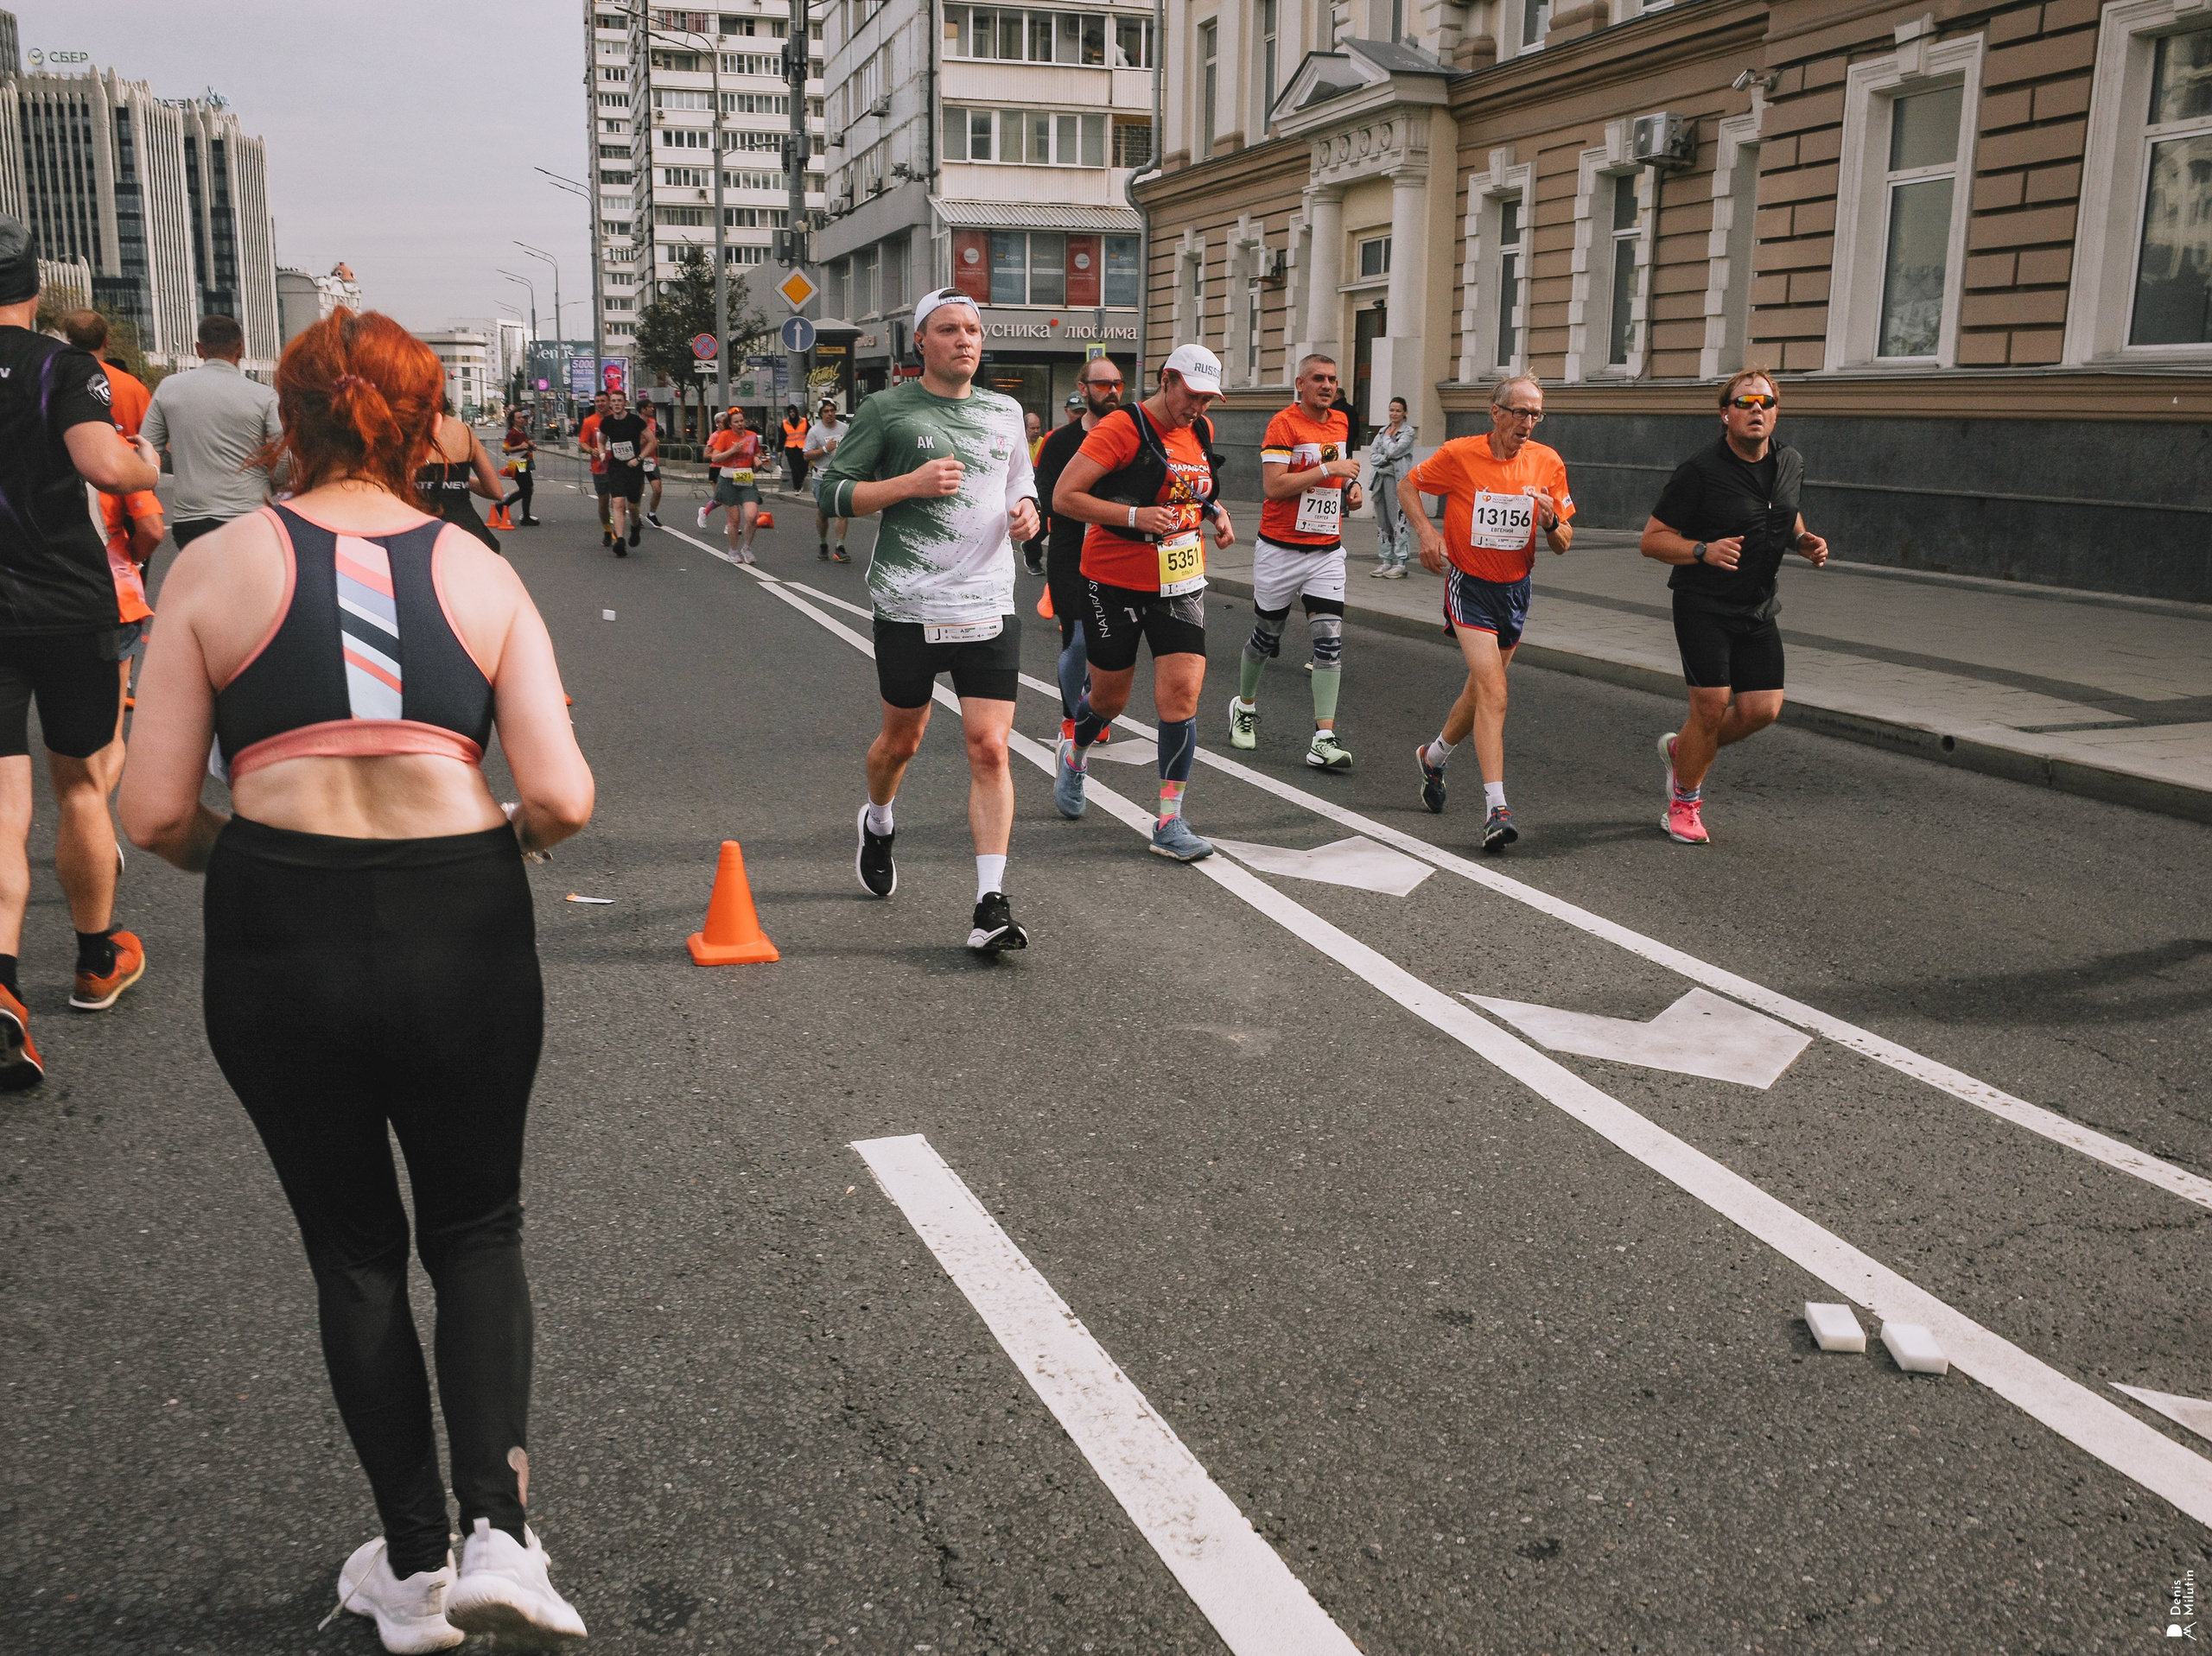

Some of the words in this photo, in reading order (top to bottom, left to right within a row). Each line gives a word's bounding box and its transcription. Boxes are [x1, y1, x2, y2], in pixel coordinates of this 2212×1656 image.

[49, 51, 88, 63] СБЕР
[571, 359, 594, 369] 5000
[1306, 498, 1337, 515] 7183
[1477, 507, 1530, 527] 13156
[1167, 547, 1199, 571] 5351
